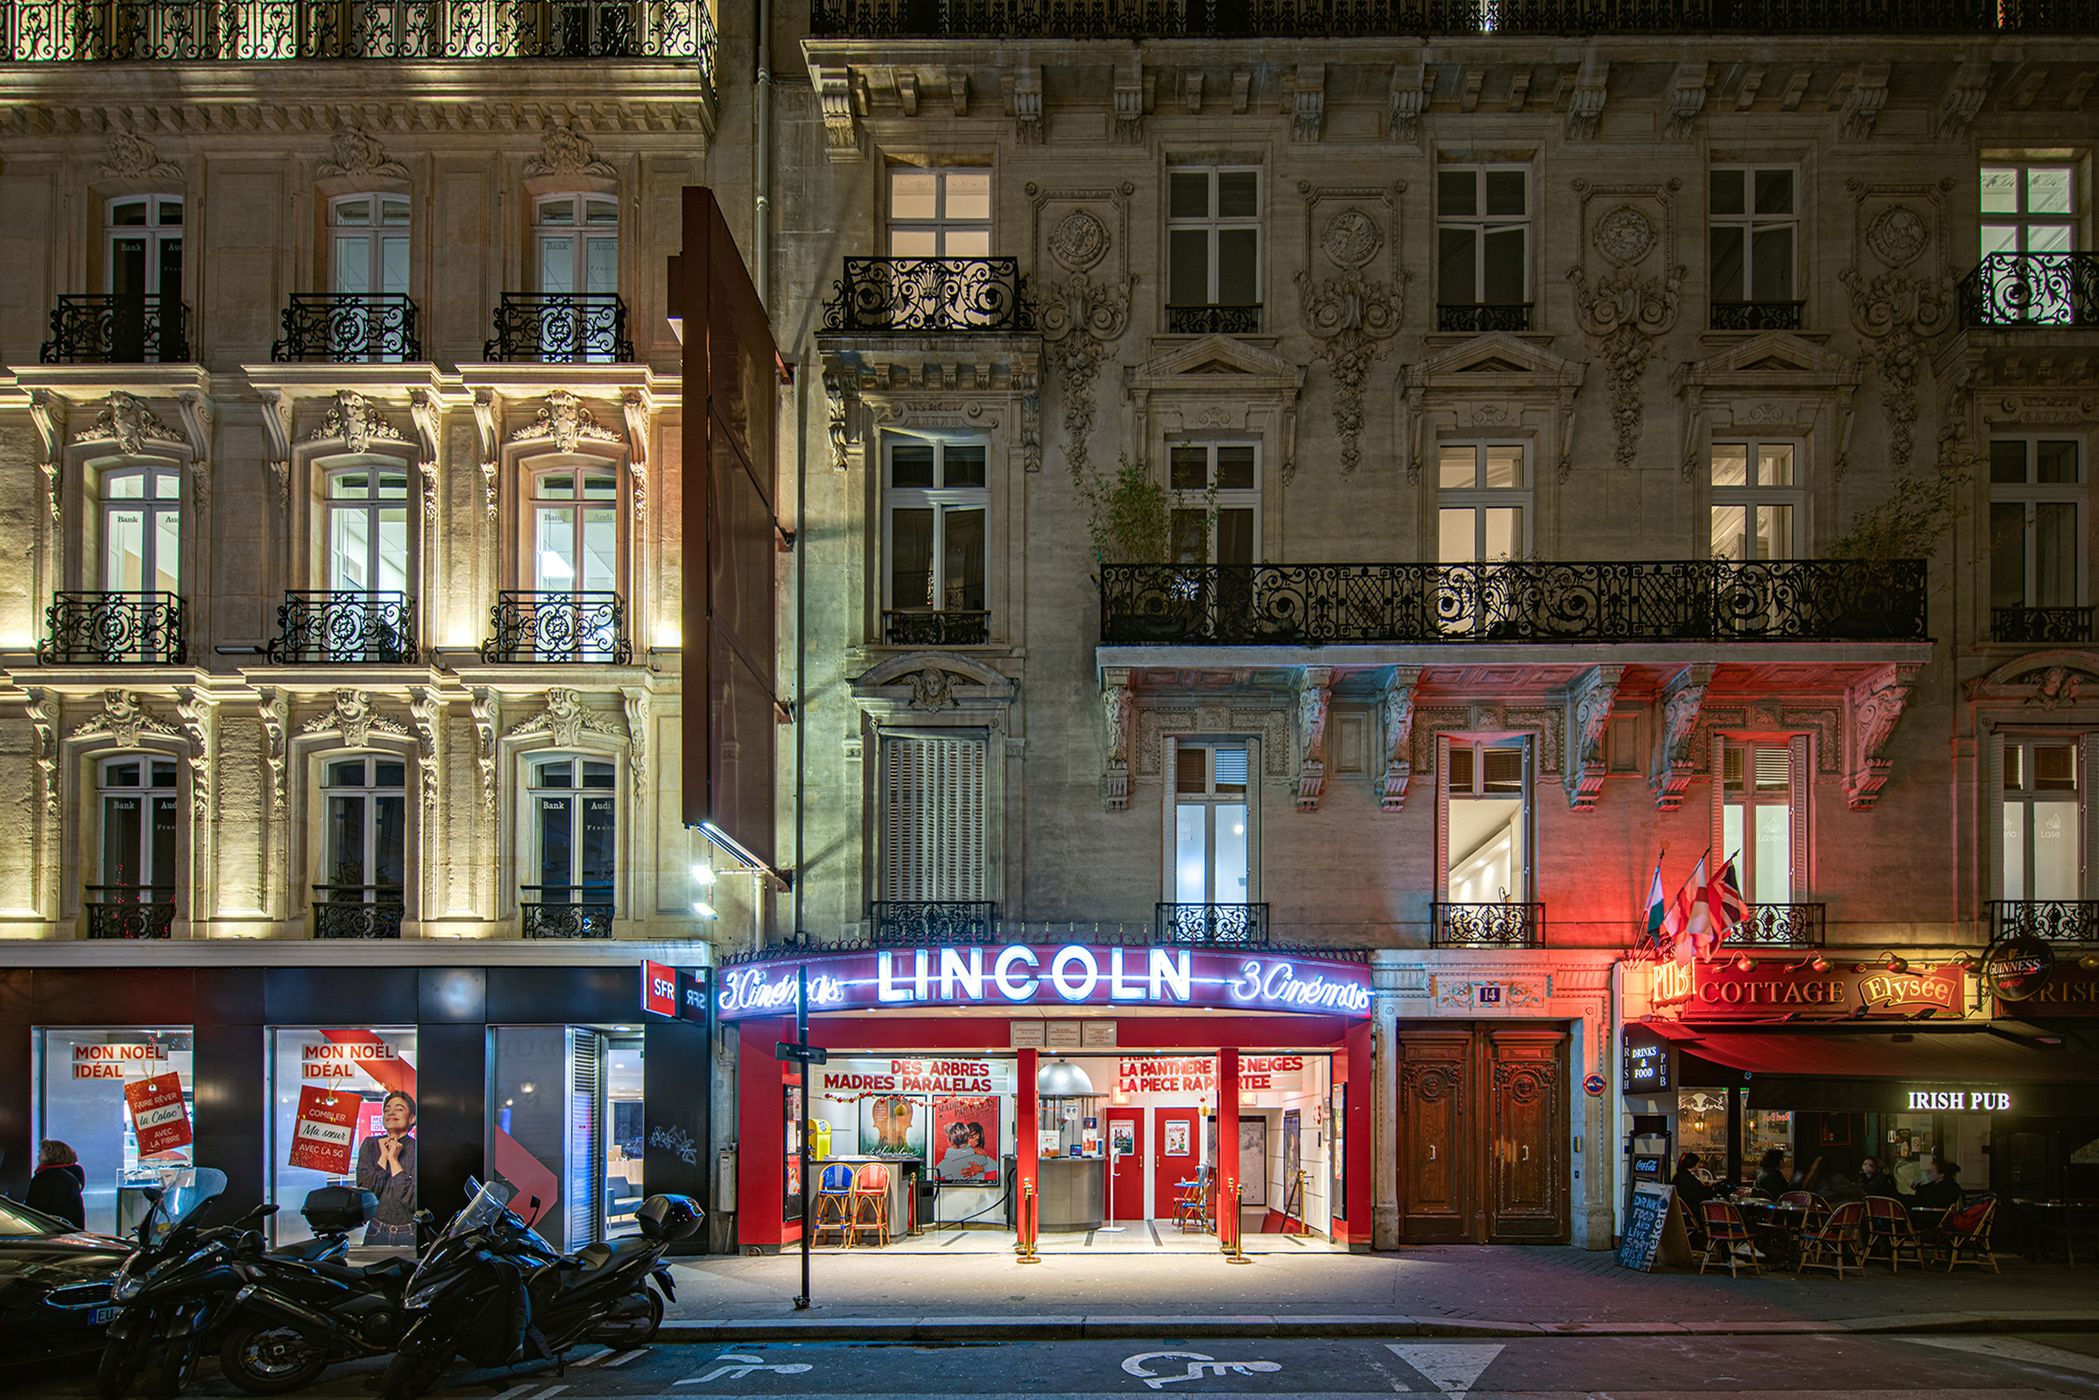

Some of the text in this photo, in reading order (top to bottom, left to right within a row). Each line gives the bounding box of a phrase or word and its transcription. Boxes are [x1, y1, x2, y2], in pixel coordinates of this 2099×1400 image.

[113, 800, 135, 809] Bank
[543, 801, 611, 810] Bank Audi
[878, 944, 1192, 1002] LINCOLN
[1989, 958, 2041, 975] GUINNESS
[653, 978, 675, 1000] SFR
[720, 972, 741, 1010] 3
[1233, 960, 1370, 1011] 3 Cinémas
[1699, 980, 1846, 1003] COTTAGE
[1864, 974, 1950, 1003] Elysée
[1484, 988, 1496, 1001] 14
[75, 1043, 164, 1059] MON NOËL
[305, 1042, 394, 1059] MON NOËL
[1632, 1046, 1658, 1059] DRINKS
[75, 1062, 124, 1078] IDÉAL
[305, 1061, 353, 1078] IDÉAL
[891, 1060, 990, 1077] DES ARBRES
[1120, 1060, 1212, 1077] LA PANTHERE
[1247, 1056, 1304, 1073] NEIGES
[1641, 1058, 1648, 1068] &
[1660, 1053, 1668, 1087] PUB
[1634, 1067, 1655, 1079] FOOD
[824, 1073, 993, 1093] MADRES PARALELAS
[1120, 1079, 1138, 1093] LA
[1140, 1077, 1180, 1092] PIECE
[134, 1098, 155, 1109] FAIRE
[1908, 1092, 2011, 1110] IRISH PUB
[154, 1127, 174, 1138] AVEC
[302, 1123, 320, 1136] Ma
[299, 1143, 344, 1159] AVEC LA 5G
[1633, 1209, 1655, 1222] FOOD
[1636, 1220, 1650, 1230] AND
